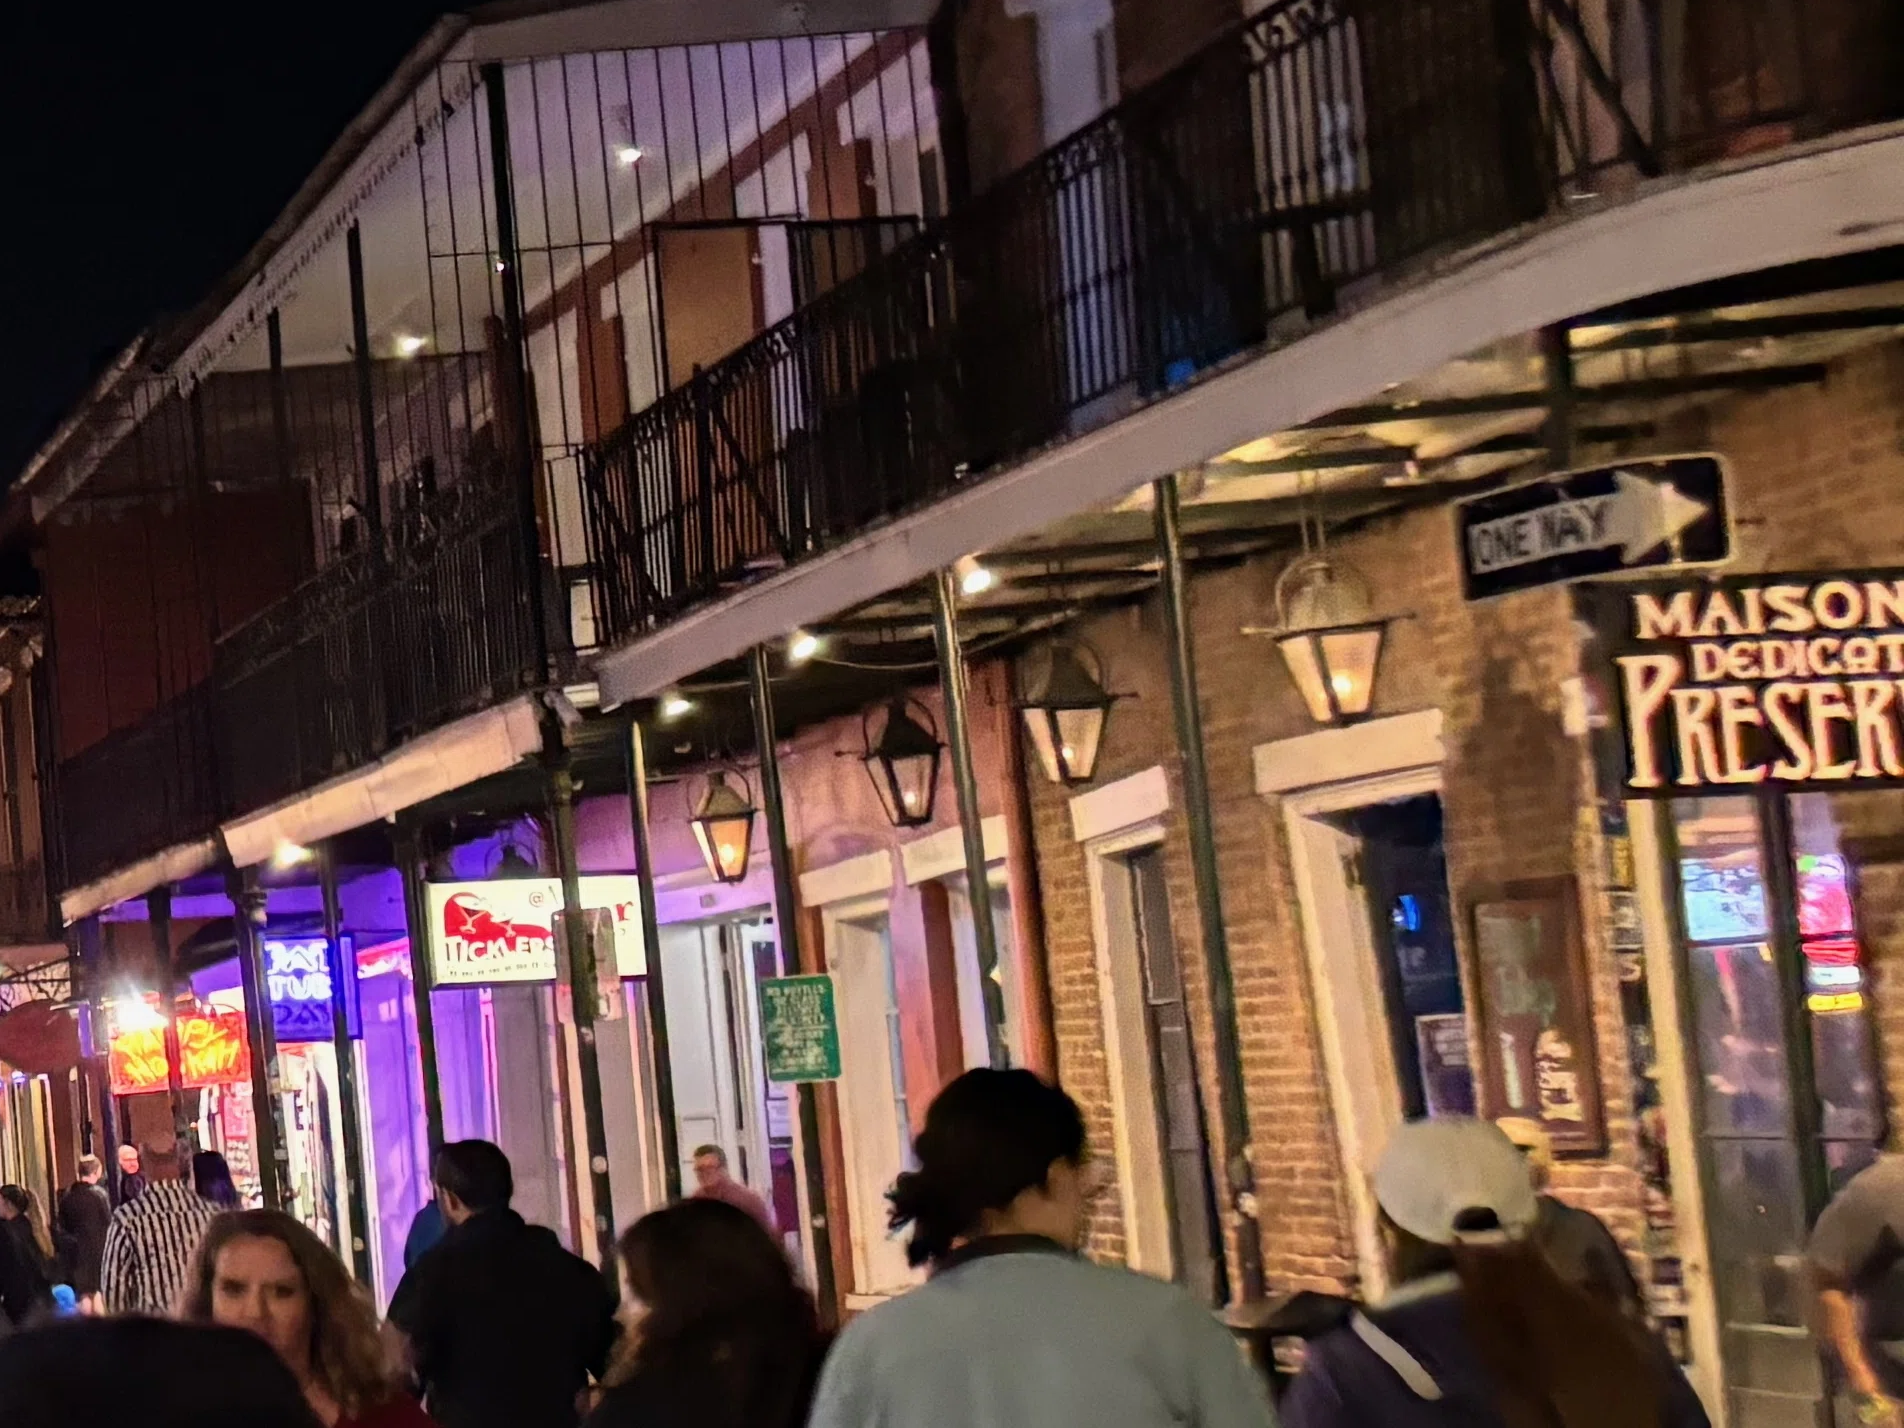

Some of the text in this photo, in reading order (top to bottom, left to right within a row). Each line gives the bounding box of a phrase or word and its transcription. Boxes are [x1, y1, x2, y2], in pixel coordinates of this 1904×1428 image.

[1476, 499, 1613, 566] ONE WAY
[1632, 580, 1904, 640] MAISON
[1614, 654, 1904, 788] PRESER
